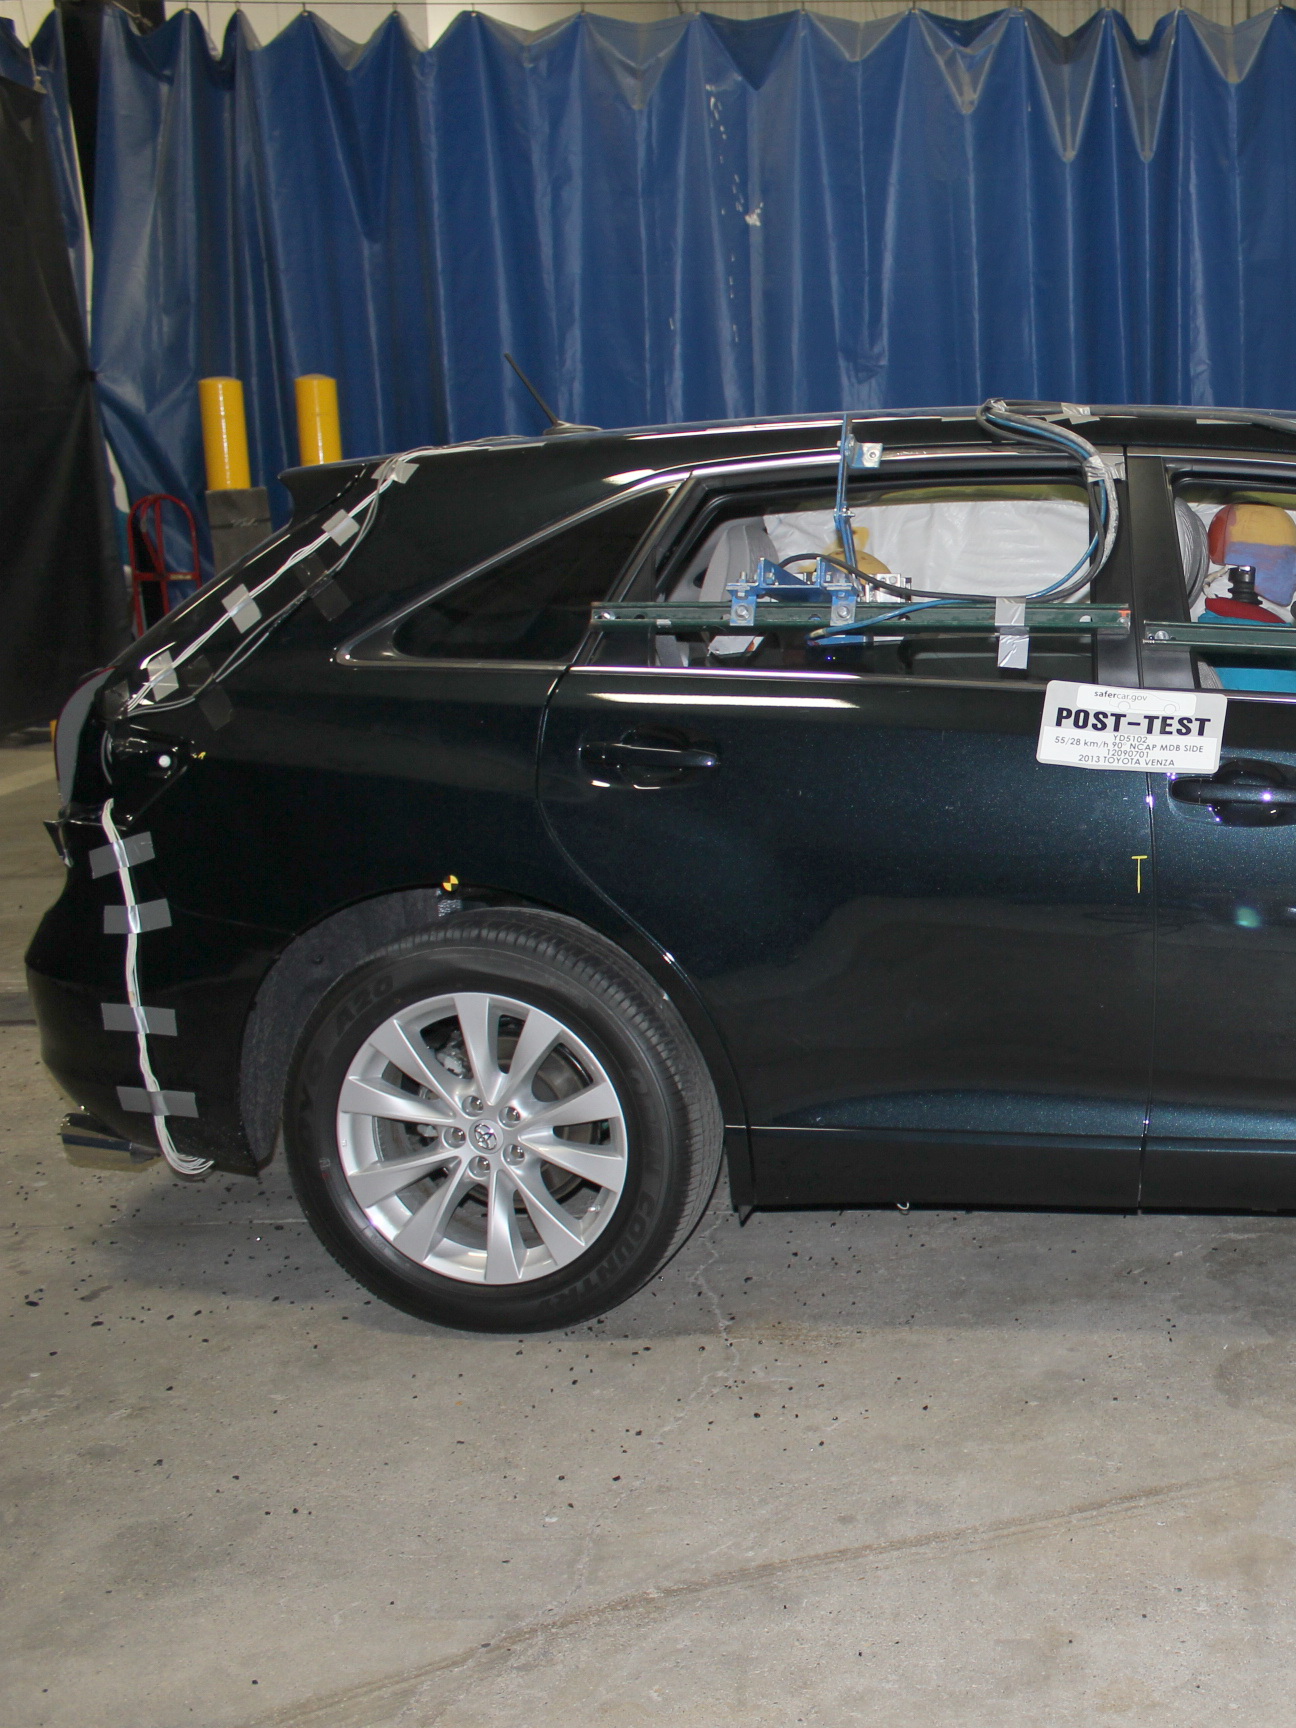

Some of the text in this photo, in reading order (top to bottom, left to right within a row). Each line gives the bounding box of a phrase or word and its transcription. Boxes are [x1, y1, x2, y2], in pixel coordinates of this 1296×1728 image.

[1094, 690, 1148, 702] safercar.gov
[1055, 707, 1211, 737] POST-TEST
[1054, 736, 1081, 746] 55/28
[1083, 739, 1109, 748] km/h
[1129, 743, 1157, 752] NCAP
[1159, 744, 1181, 752] MDB
[1183, 745, 1204, 753] SIDE
[1113, 734, 1148, 744] YD5102
[1107, 749, 1149, 759] 12090701
[1078, 754, 1175, 767] 2013 TOYOTA VENZA
